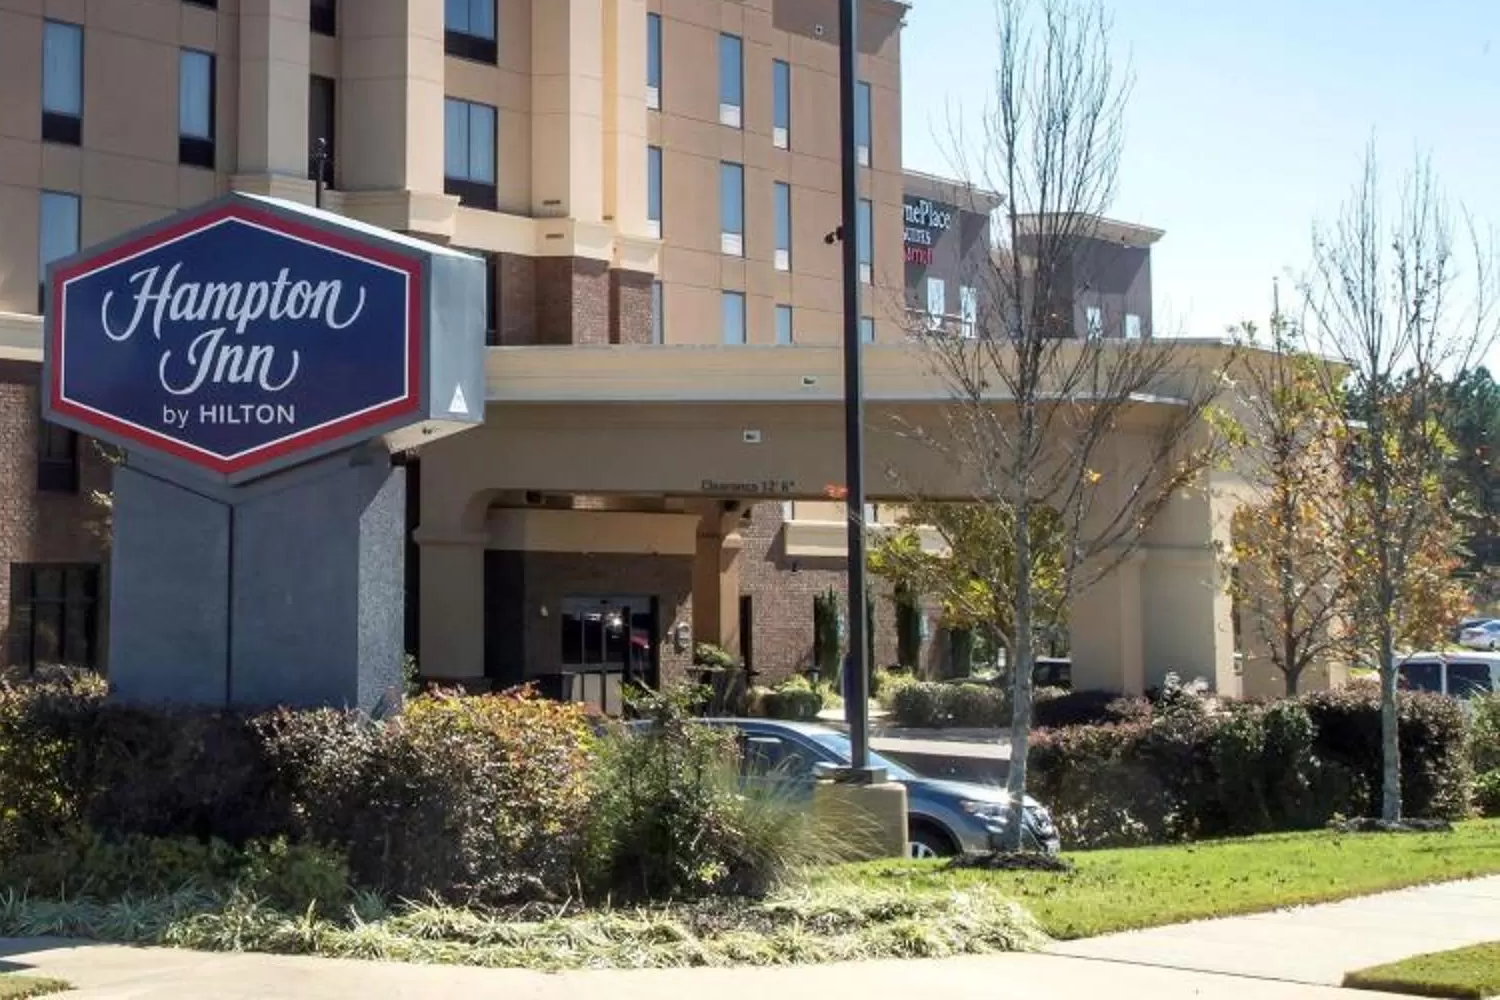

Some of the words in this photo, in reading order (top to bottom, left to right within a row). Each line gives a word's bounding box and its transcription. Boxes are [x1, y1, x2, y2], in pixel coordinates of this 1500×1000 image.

[101, 261, 366, 341] Hampton
[159, 328, 300, 394] Inn
[163, 405, 190, 428] by
[199, 405, 296, 424] HILTON
